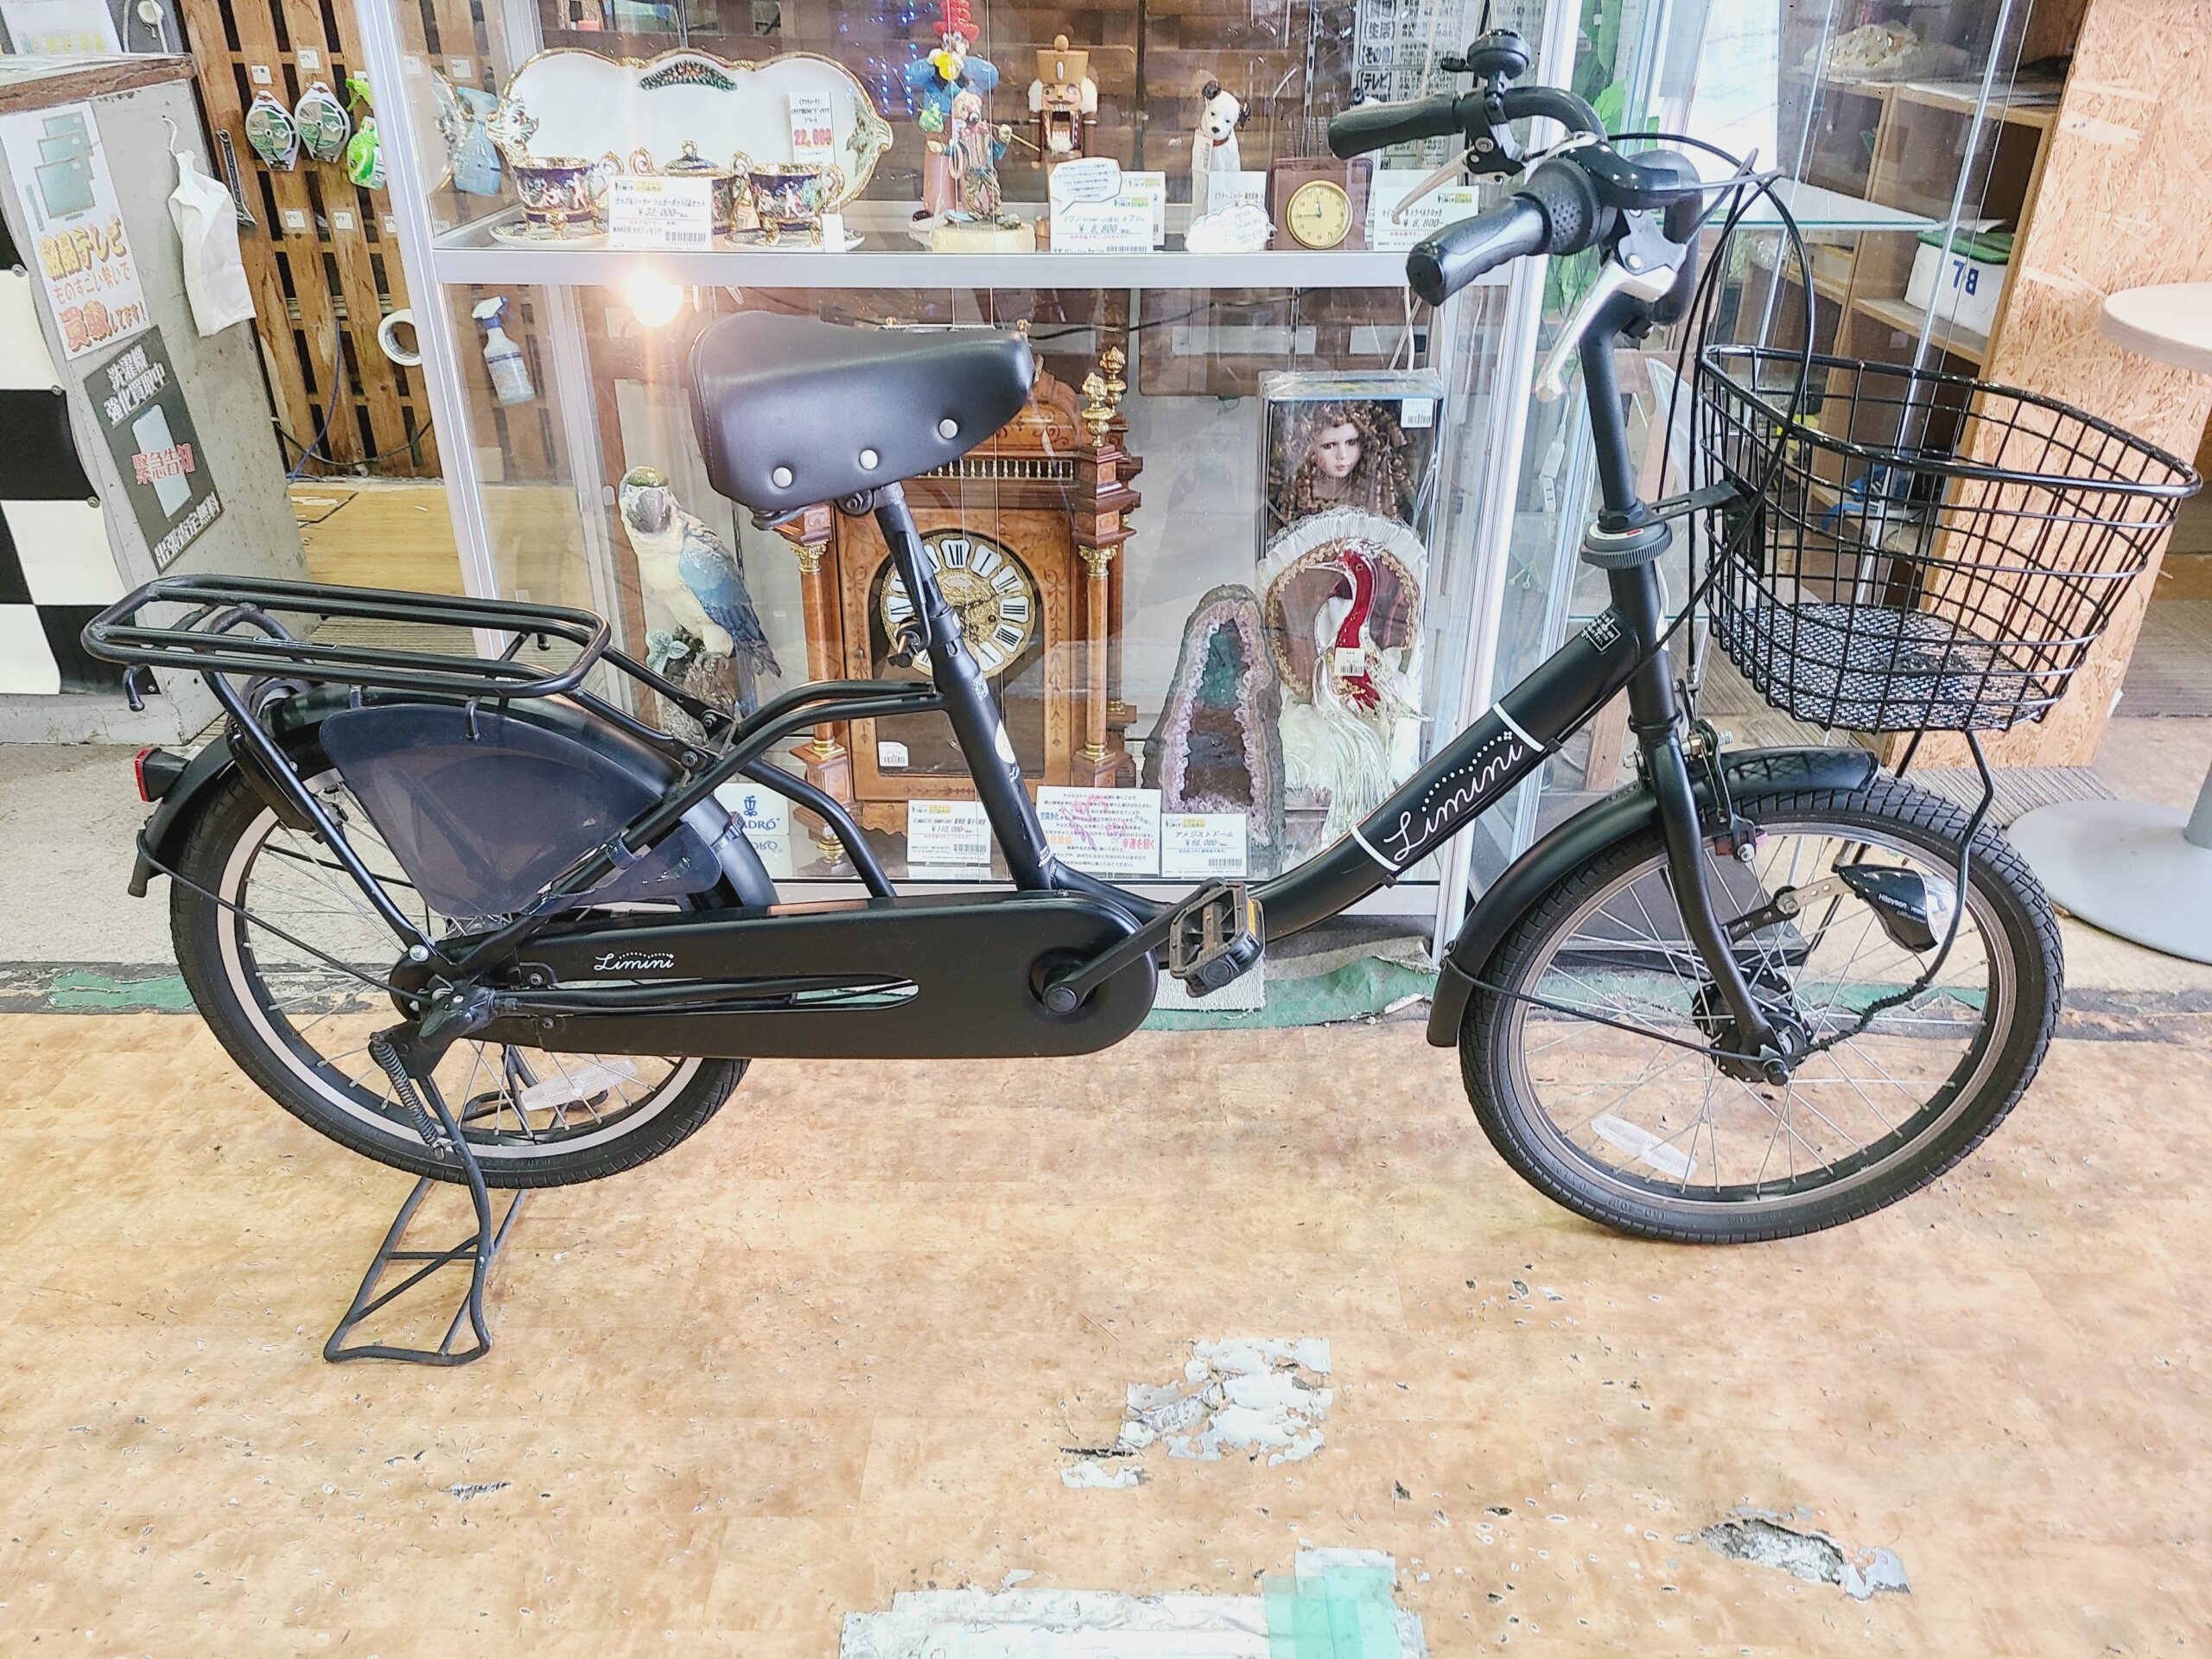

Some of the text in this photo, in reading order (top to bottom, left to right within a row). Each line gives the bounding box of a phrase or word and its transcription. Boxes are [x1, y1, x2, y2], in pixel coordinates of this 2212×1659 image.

[131, 442, 195, 486] 緊急告知
[1383, 743, 1523, 862] Limini
[1122, 838, 1155, 850] 幸運を招く
[594, 952, 674, 970] Limini
